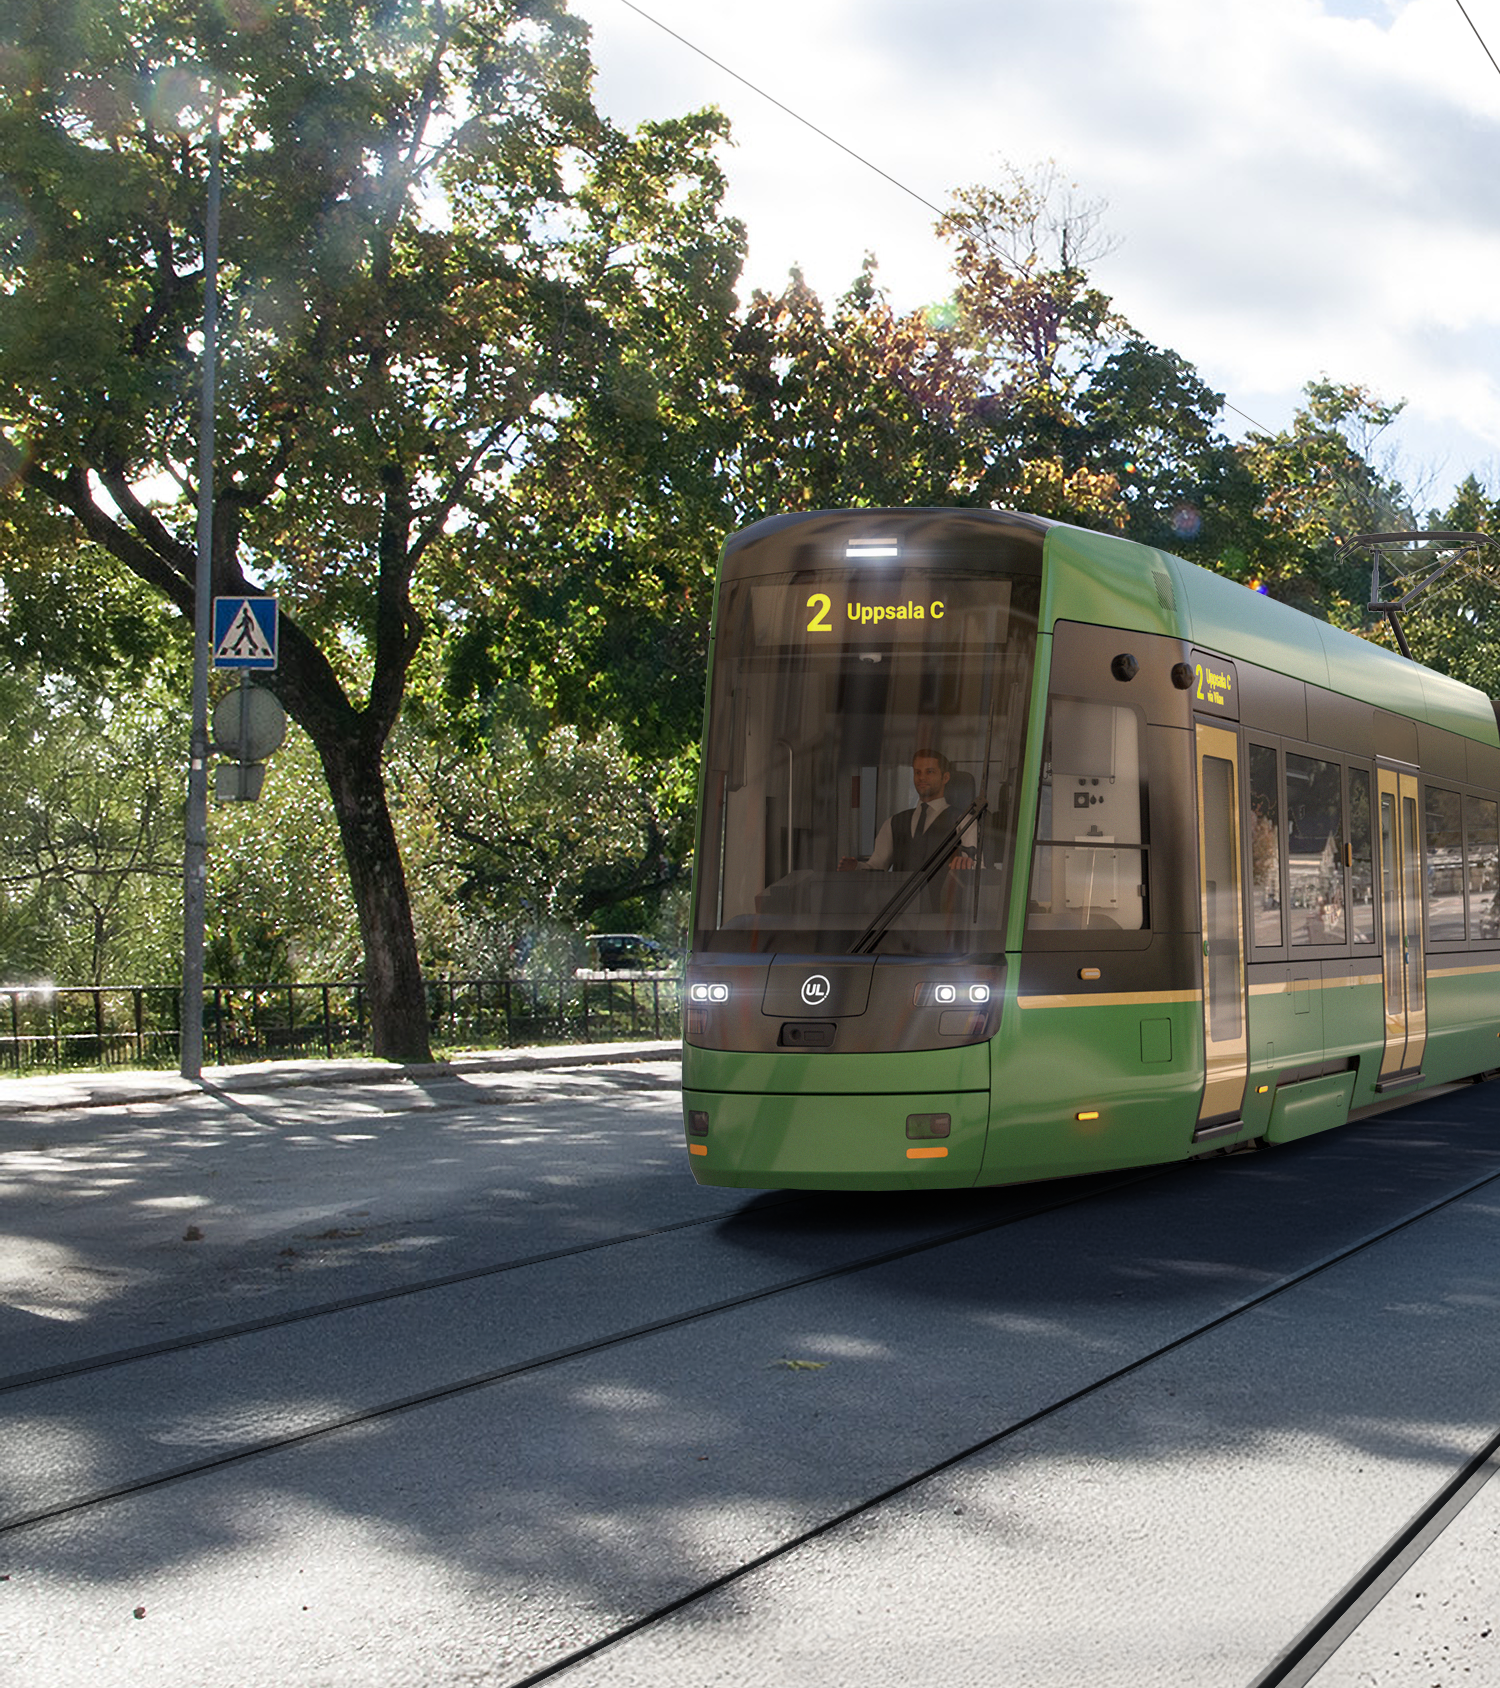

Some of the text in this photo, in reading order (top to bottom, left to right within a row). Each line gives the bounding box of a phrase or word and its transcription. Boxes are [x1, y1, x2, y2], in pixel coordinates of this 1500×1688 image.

[806, 593, 945, 632] 2 Uppsala C
[1196, 664, 1231, 700] 2 Uppsala C
[805, 983, 825, 997] UL
